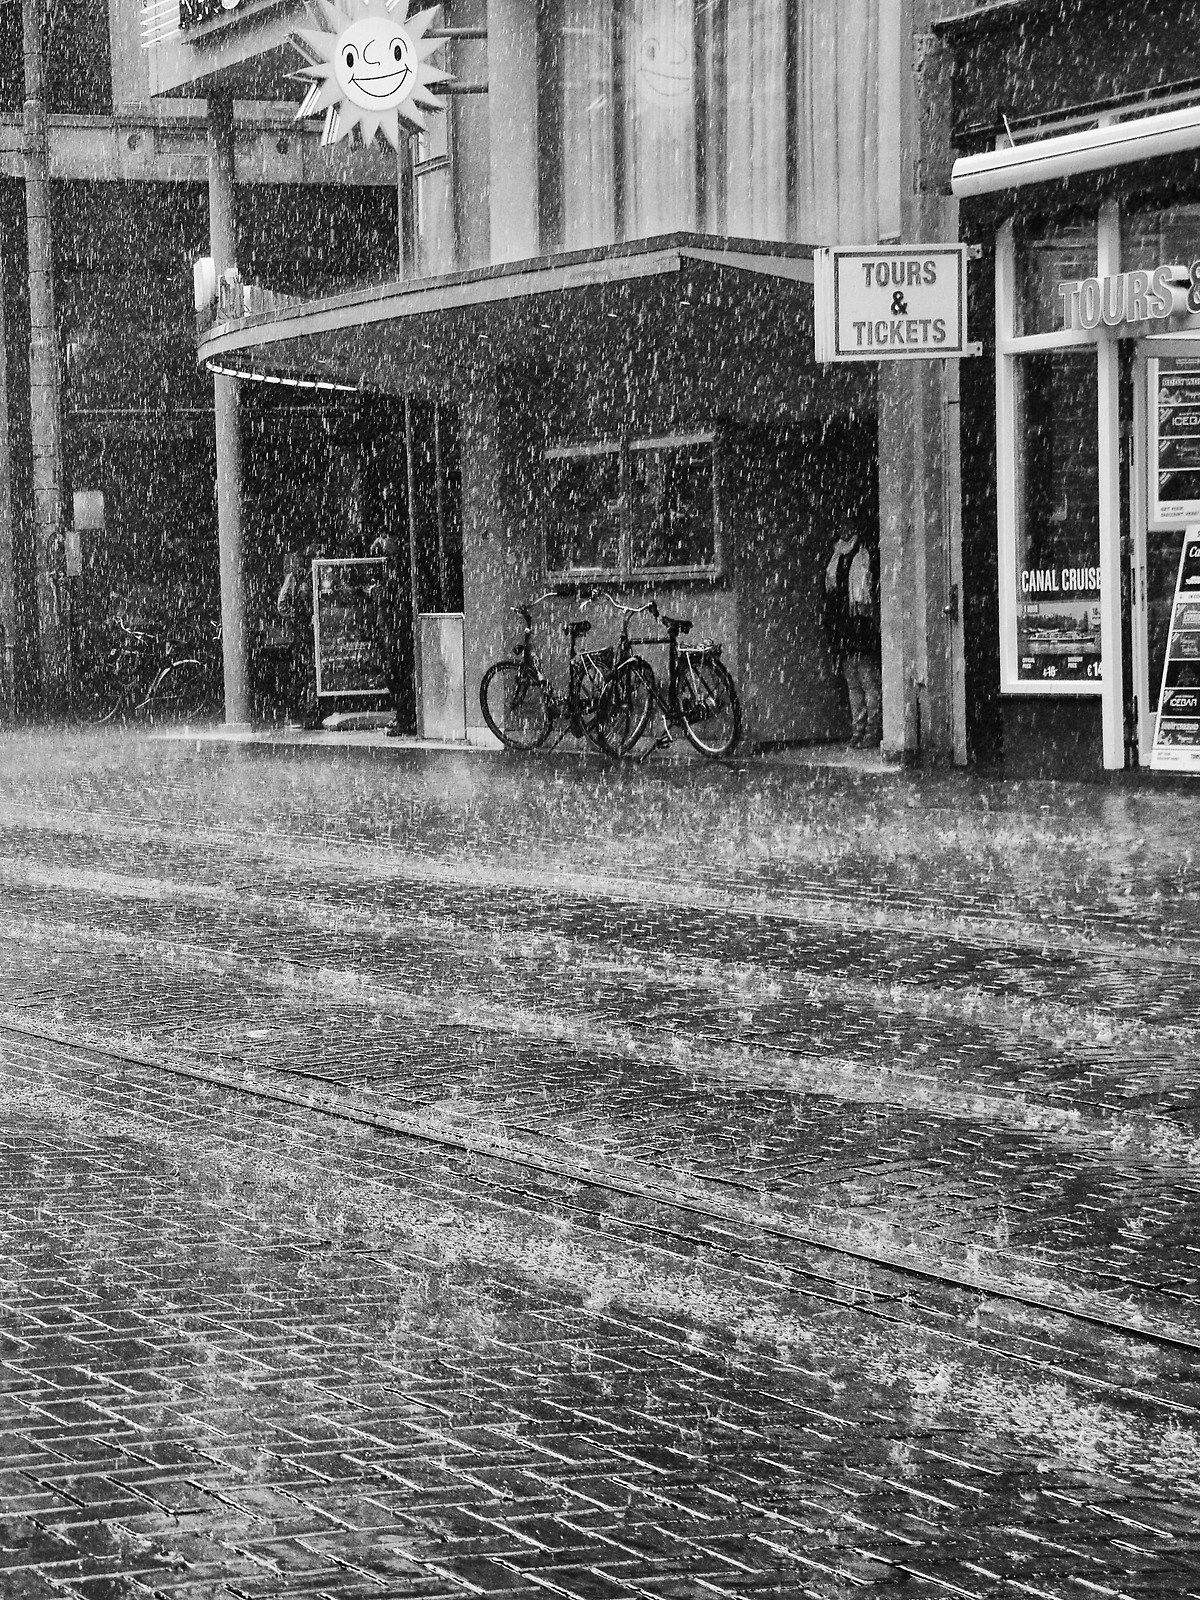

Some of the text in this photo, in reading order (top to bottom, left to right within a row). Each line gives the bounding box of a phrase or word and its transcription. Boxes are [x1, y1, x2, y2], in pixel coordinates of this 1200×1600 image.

[862, 260, 937, 287] TOURS
[890, 291, 908, 315] &
[1059, 265, 1174, 330] TOURS
[853, 318, 946, 345] TICKETS
[1021, 569, 1060, 592] CANAL
